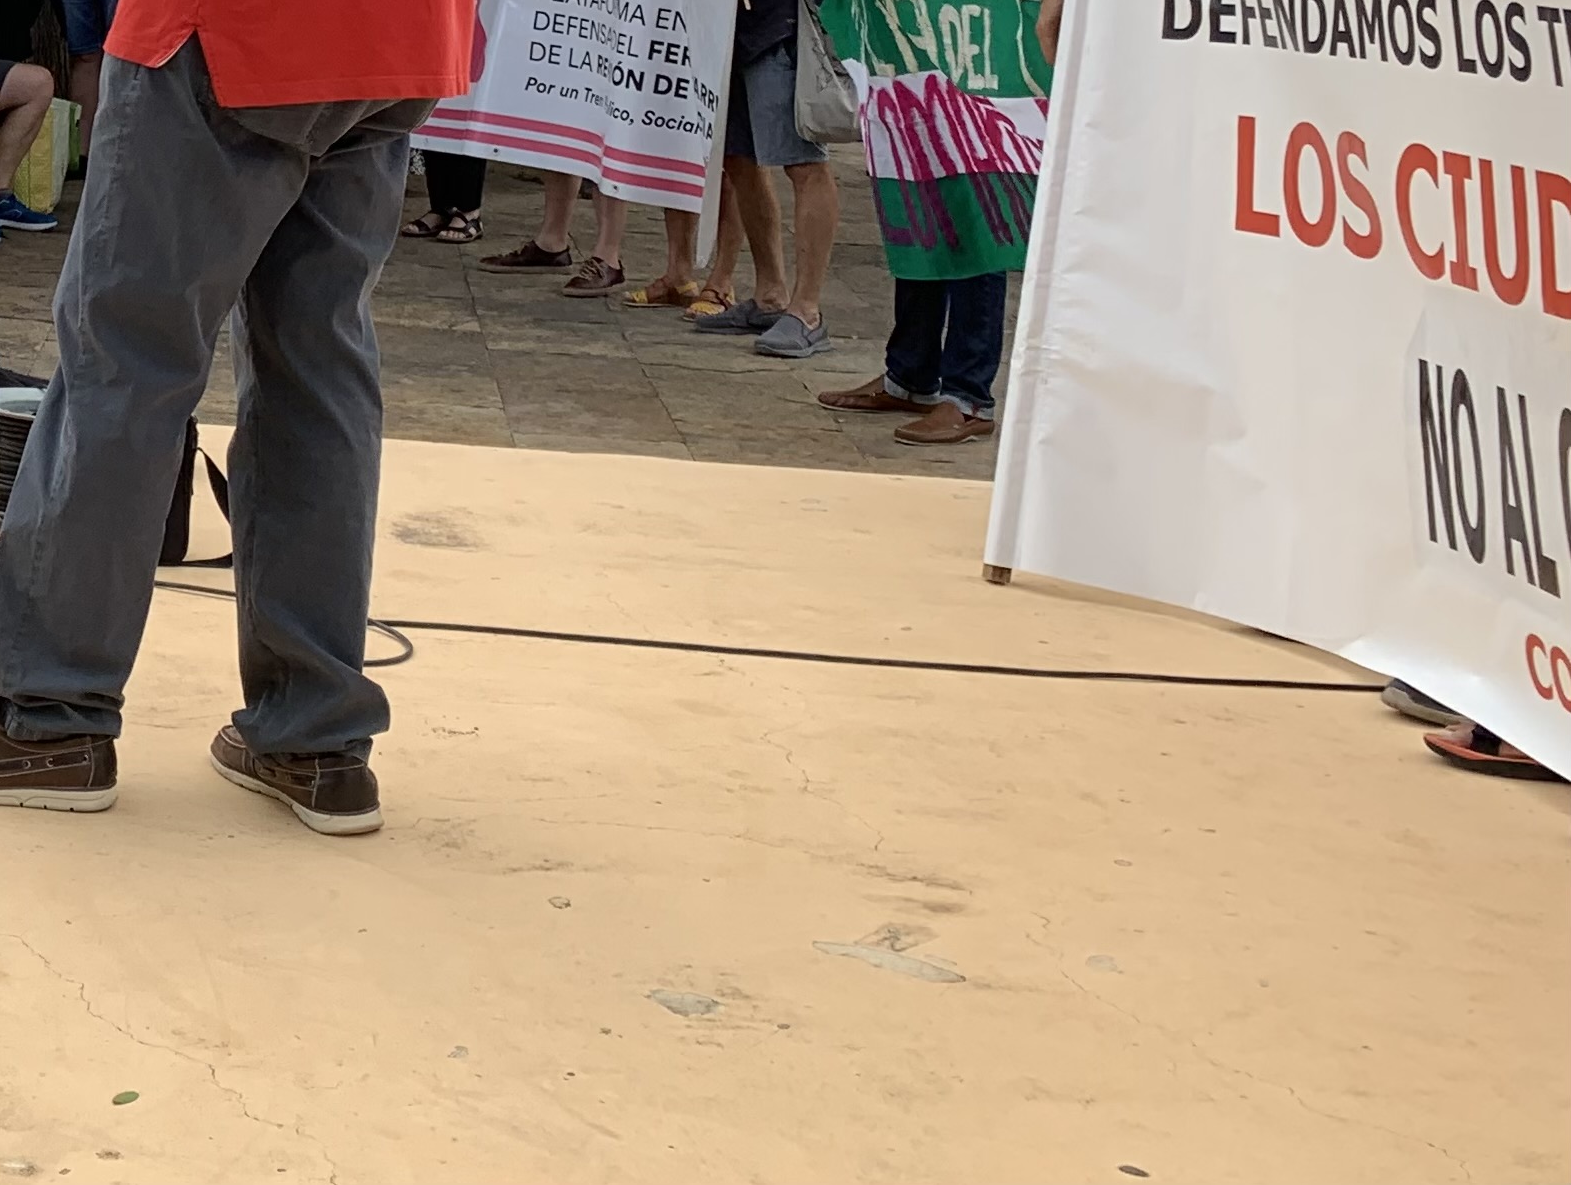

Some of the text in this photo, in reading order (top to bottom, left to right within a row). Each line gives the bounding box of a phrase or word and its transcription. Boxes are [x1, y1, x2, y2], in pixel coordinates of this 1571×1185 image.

[524, 76, 556, 95] Por
[559, 84, 579, 100] un
[529, 41, 690, 100] DE LA REÓN DE
[1536, 5, 1571, 88] T
[1235, 114, 1383, 260] LOS
[1418, 358, 1486, 564] NO
[1496, 385, 1561, 599] AL
